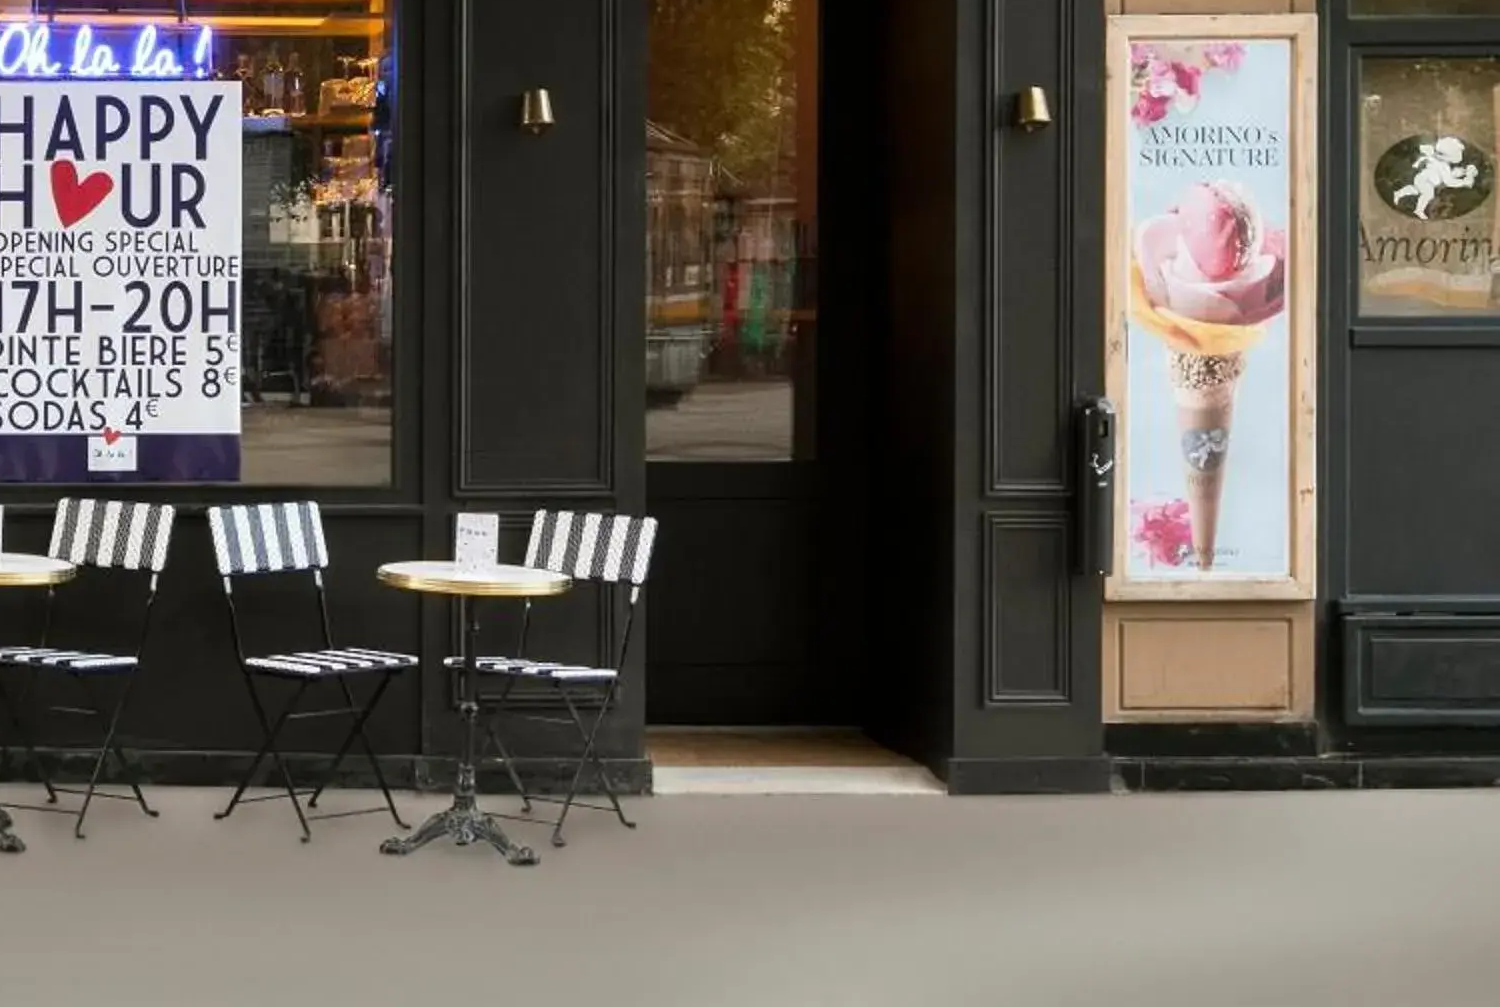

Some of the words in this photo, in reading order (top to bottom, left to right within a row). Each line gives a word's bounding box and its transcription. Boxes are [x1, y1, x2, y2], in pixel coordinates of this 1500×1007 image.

[71, 24, 120, 76] la
[131, 24, 184, 76] la
[1139, 148, 1280, 167] SIGNATURE
[105, 231, 199, 253] SPECIAL
[1360, 221, 1500, 264] Amorin
[93, 256, 239, 277] OUVERTURE
[100, 336, 187, 366] BIERE
